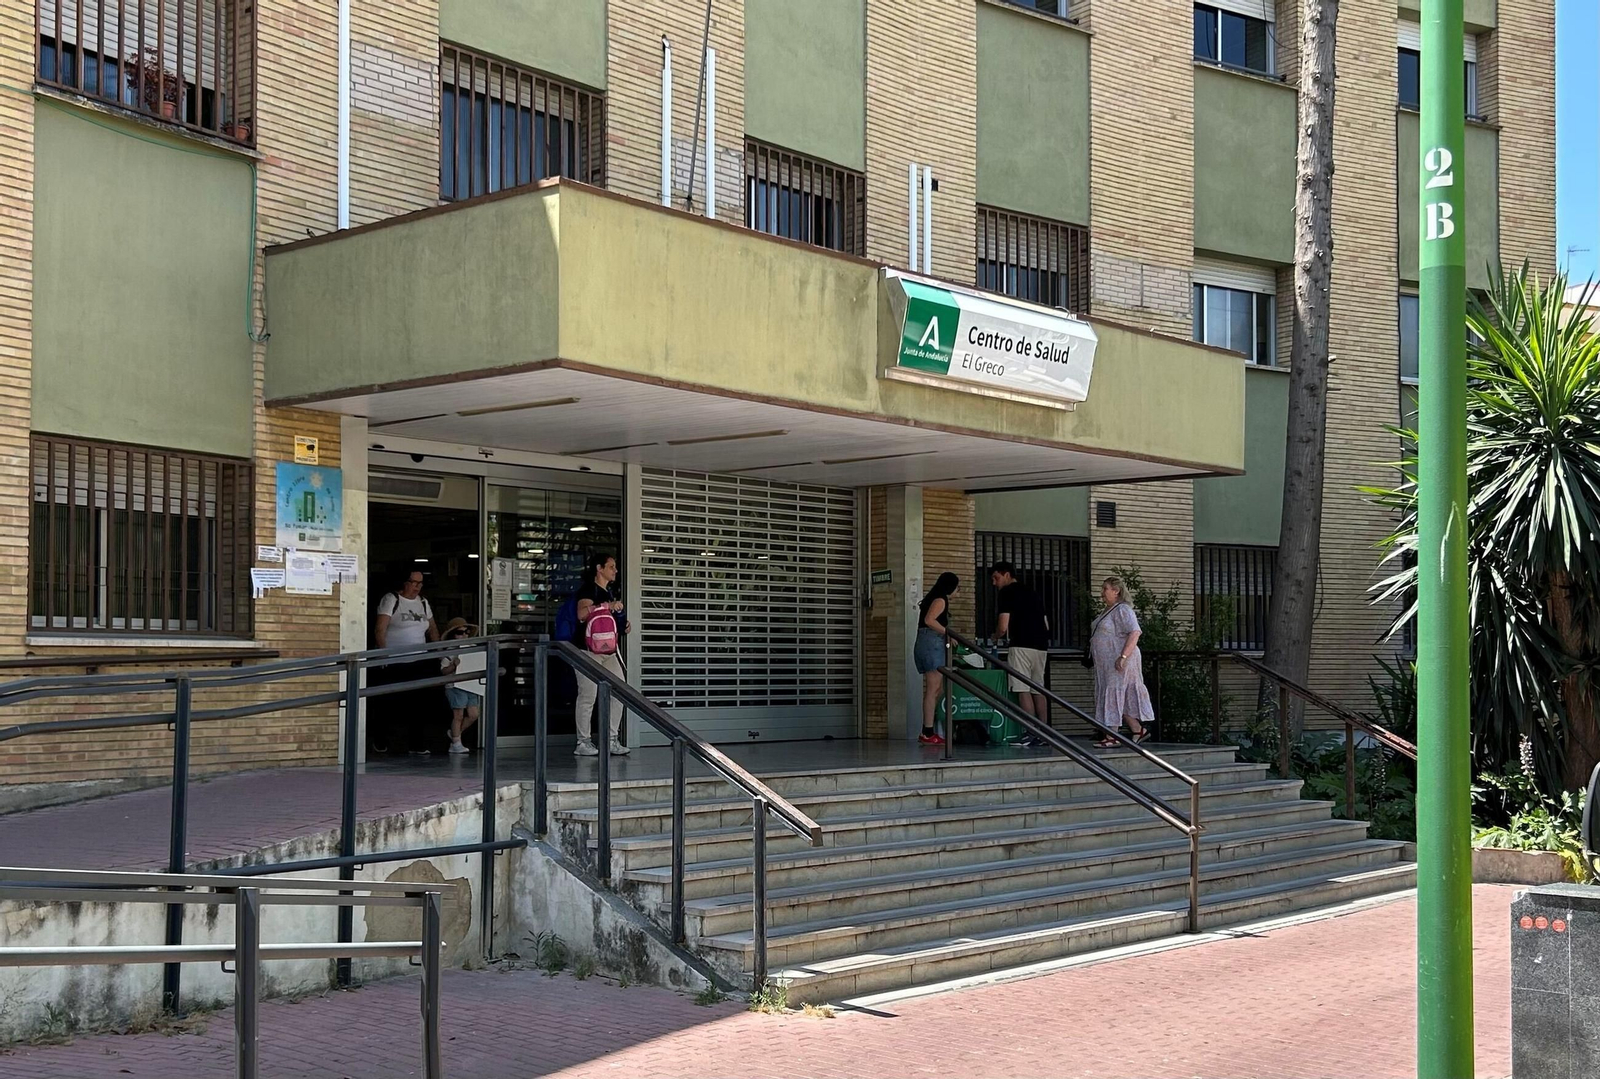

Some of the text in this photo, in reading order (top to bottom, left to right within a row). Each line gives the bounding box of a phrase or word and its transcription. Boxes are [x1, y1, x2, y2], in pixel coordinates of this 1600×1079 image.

[1424, 147, 1454, 190] 2
[1425, 202, 1455, 241] B
[903, 346, 949, 363] Junta de Andalucía
[961, 353, 1005, 376] El Greco
[968, 325, 1070, 365] Centro de Salud
